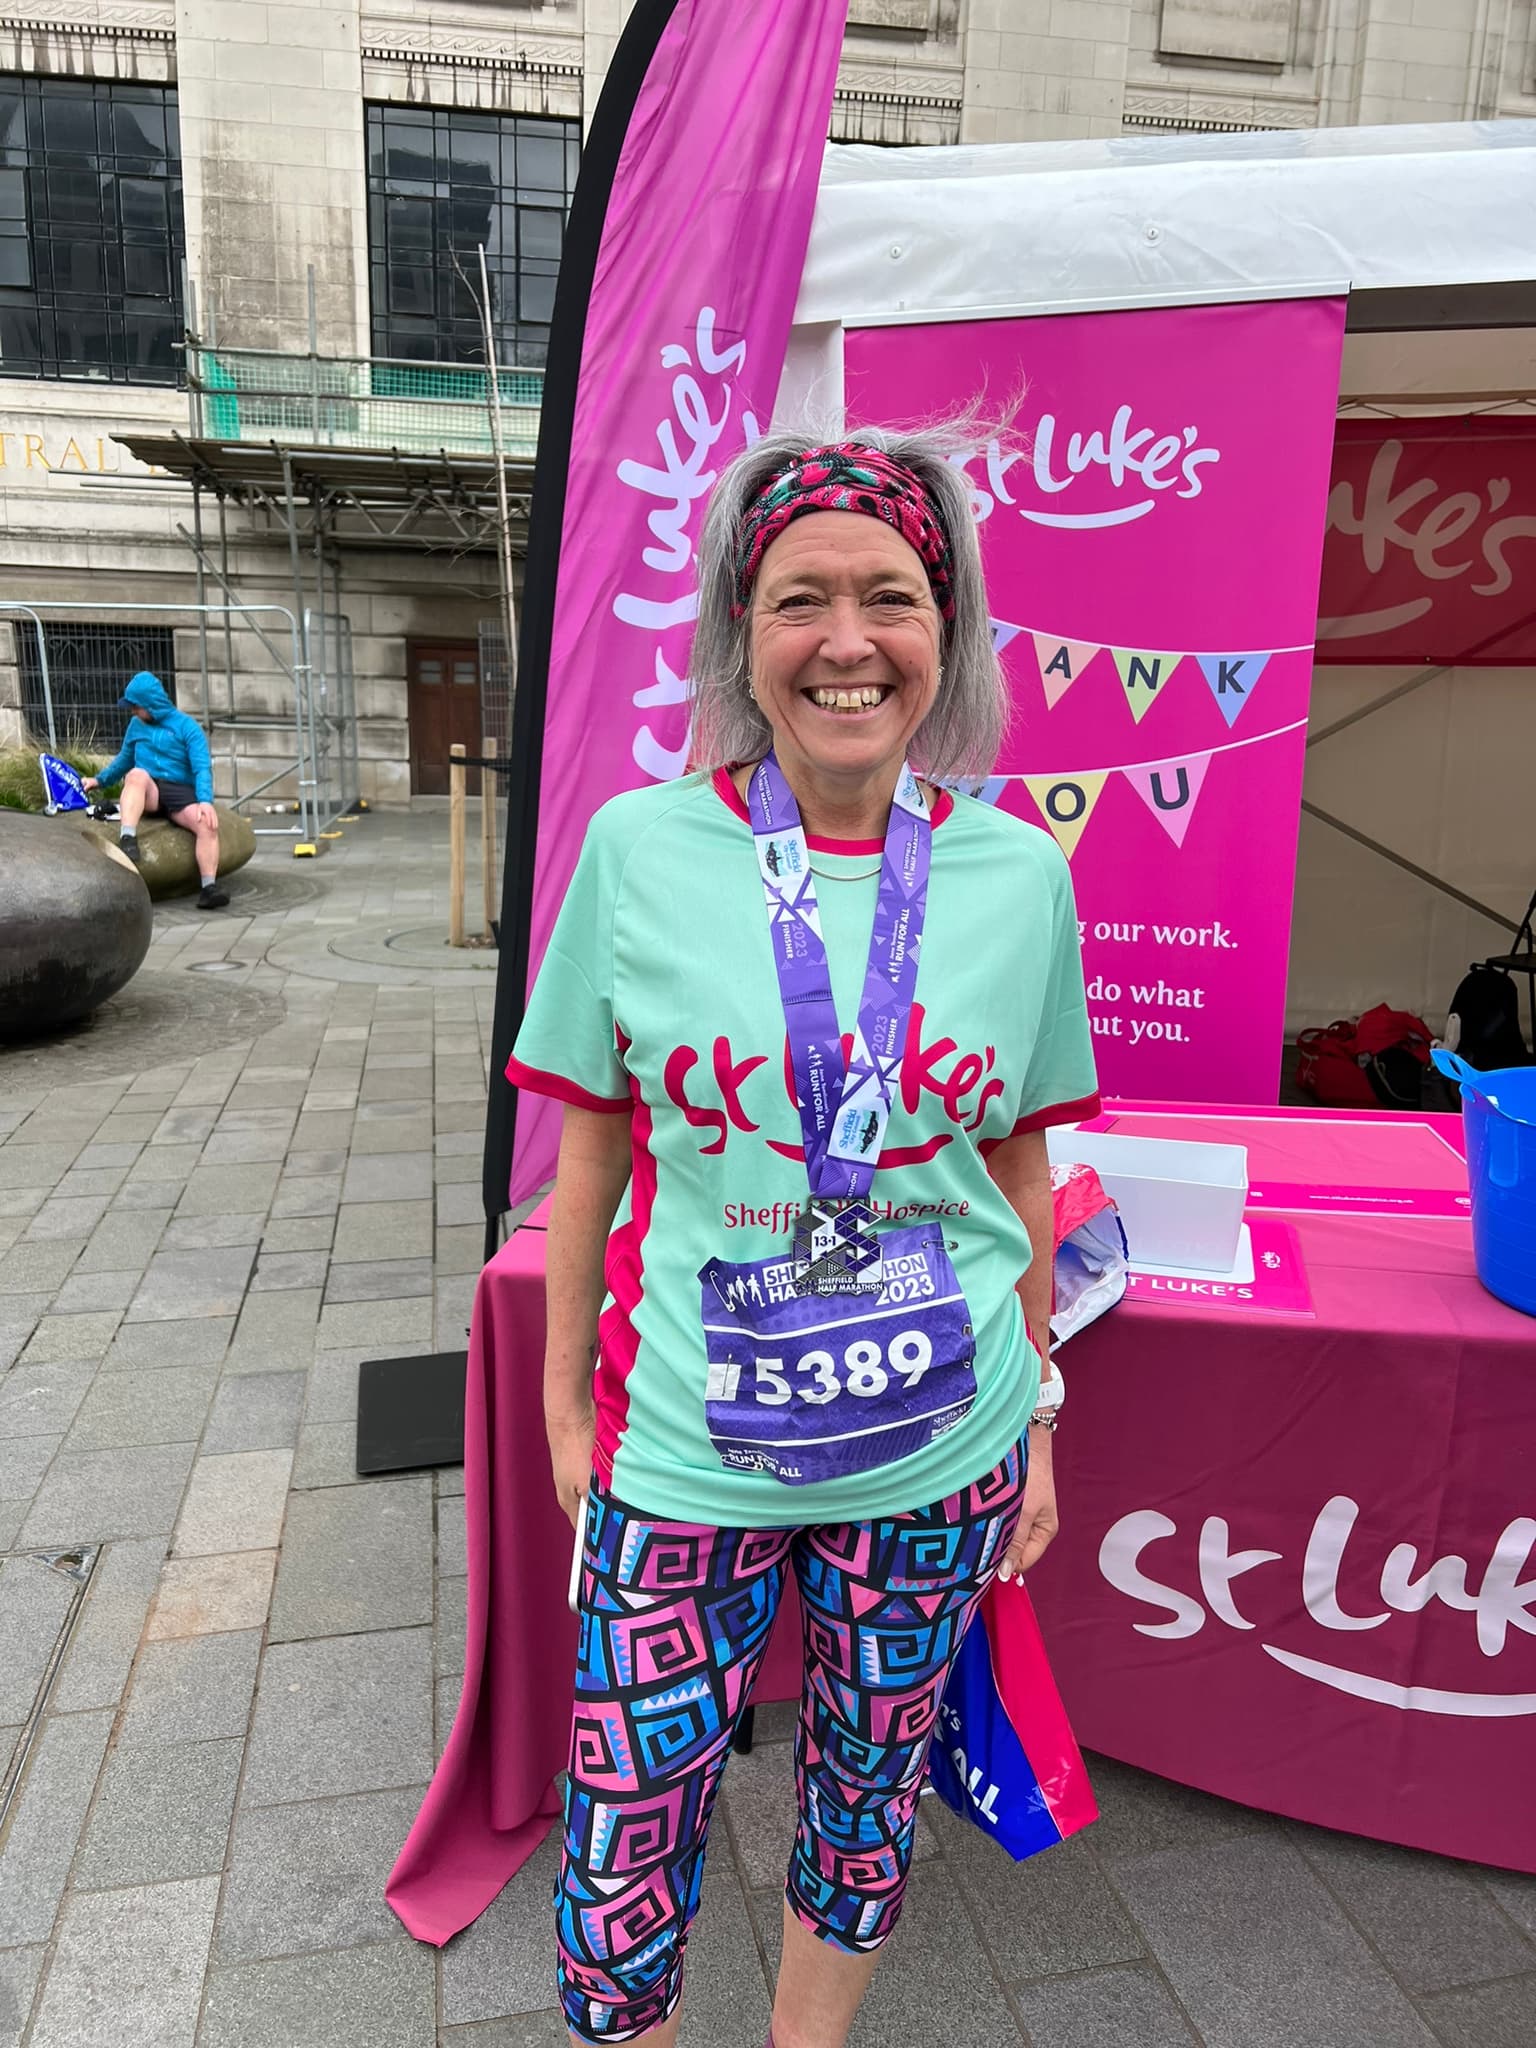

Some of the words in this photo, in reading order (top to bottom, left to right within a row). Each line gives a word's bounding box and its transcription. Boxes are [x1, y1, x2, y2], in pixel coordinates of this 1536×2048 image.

[1033, 404, 1221, 499] Luke's
[901, 908, 911, 924] ALL
[782, 923, 794, 960] FINISHER
[791, 922, 808, 959] 2023
[898, 923, 908, 941] FOR
[1094, 921, 1146, 942] our
[1152, 921, 1239, 949] work.
[895, 941, 905, 965] RUN
[1087, 975, 1122, 1002] do
[1129, 980, 1206, 1009] what
[871, 1015, 888, 1053] 2023
[885, 1017, 898, 1055] FINISHER
[1128, 1019, 1191, 1045] you.
[810, 1069, 820, 1093] RUN
[663, 1035, 769, 1155] St
[813, 1093, 823, 1113] FOR
[816, 1115, 826, 1131] ALL
[839, 1108, 857, 1149] Sheffield
[848, 1172, 858, 1199] ATHON
[872, 1198, 970, 1221] Hospice
[817, 1276, 854, 1285] SHEFFIELD
[817, 1284, 837, 1293] HALF
[838, 1283, 884, 1292] MARATHON
[875, 1276, 935, 1307] 2023
[1151, 1278, 1254, 1299] LUKE'S
[755, 1330, 933, 1405] 5389
[729, 1453, 755, 1464] RUN
[779, 1466, 803, 1478] ALL
[1098, 1509, 1283, 1640] St
[951, 1747, 1000, 1825] ALL
